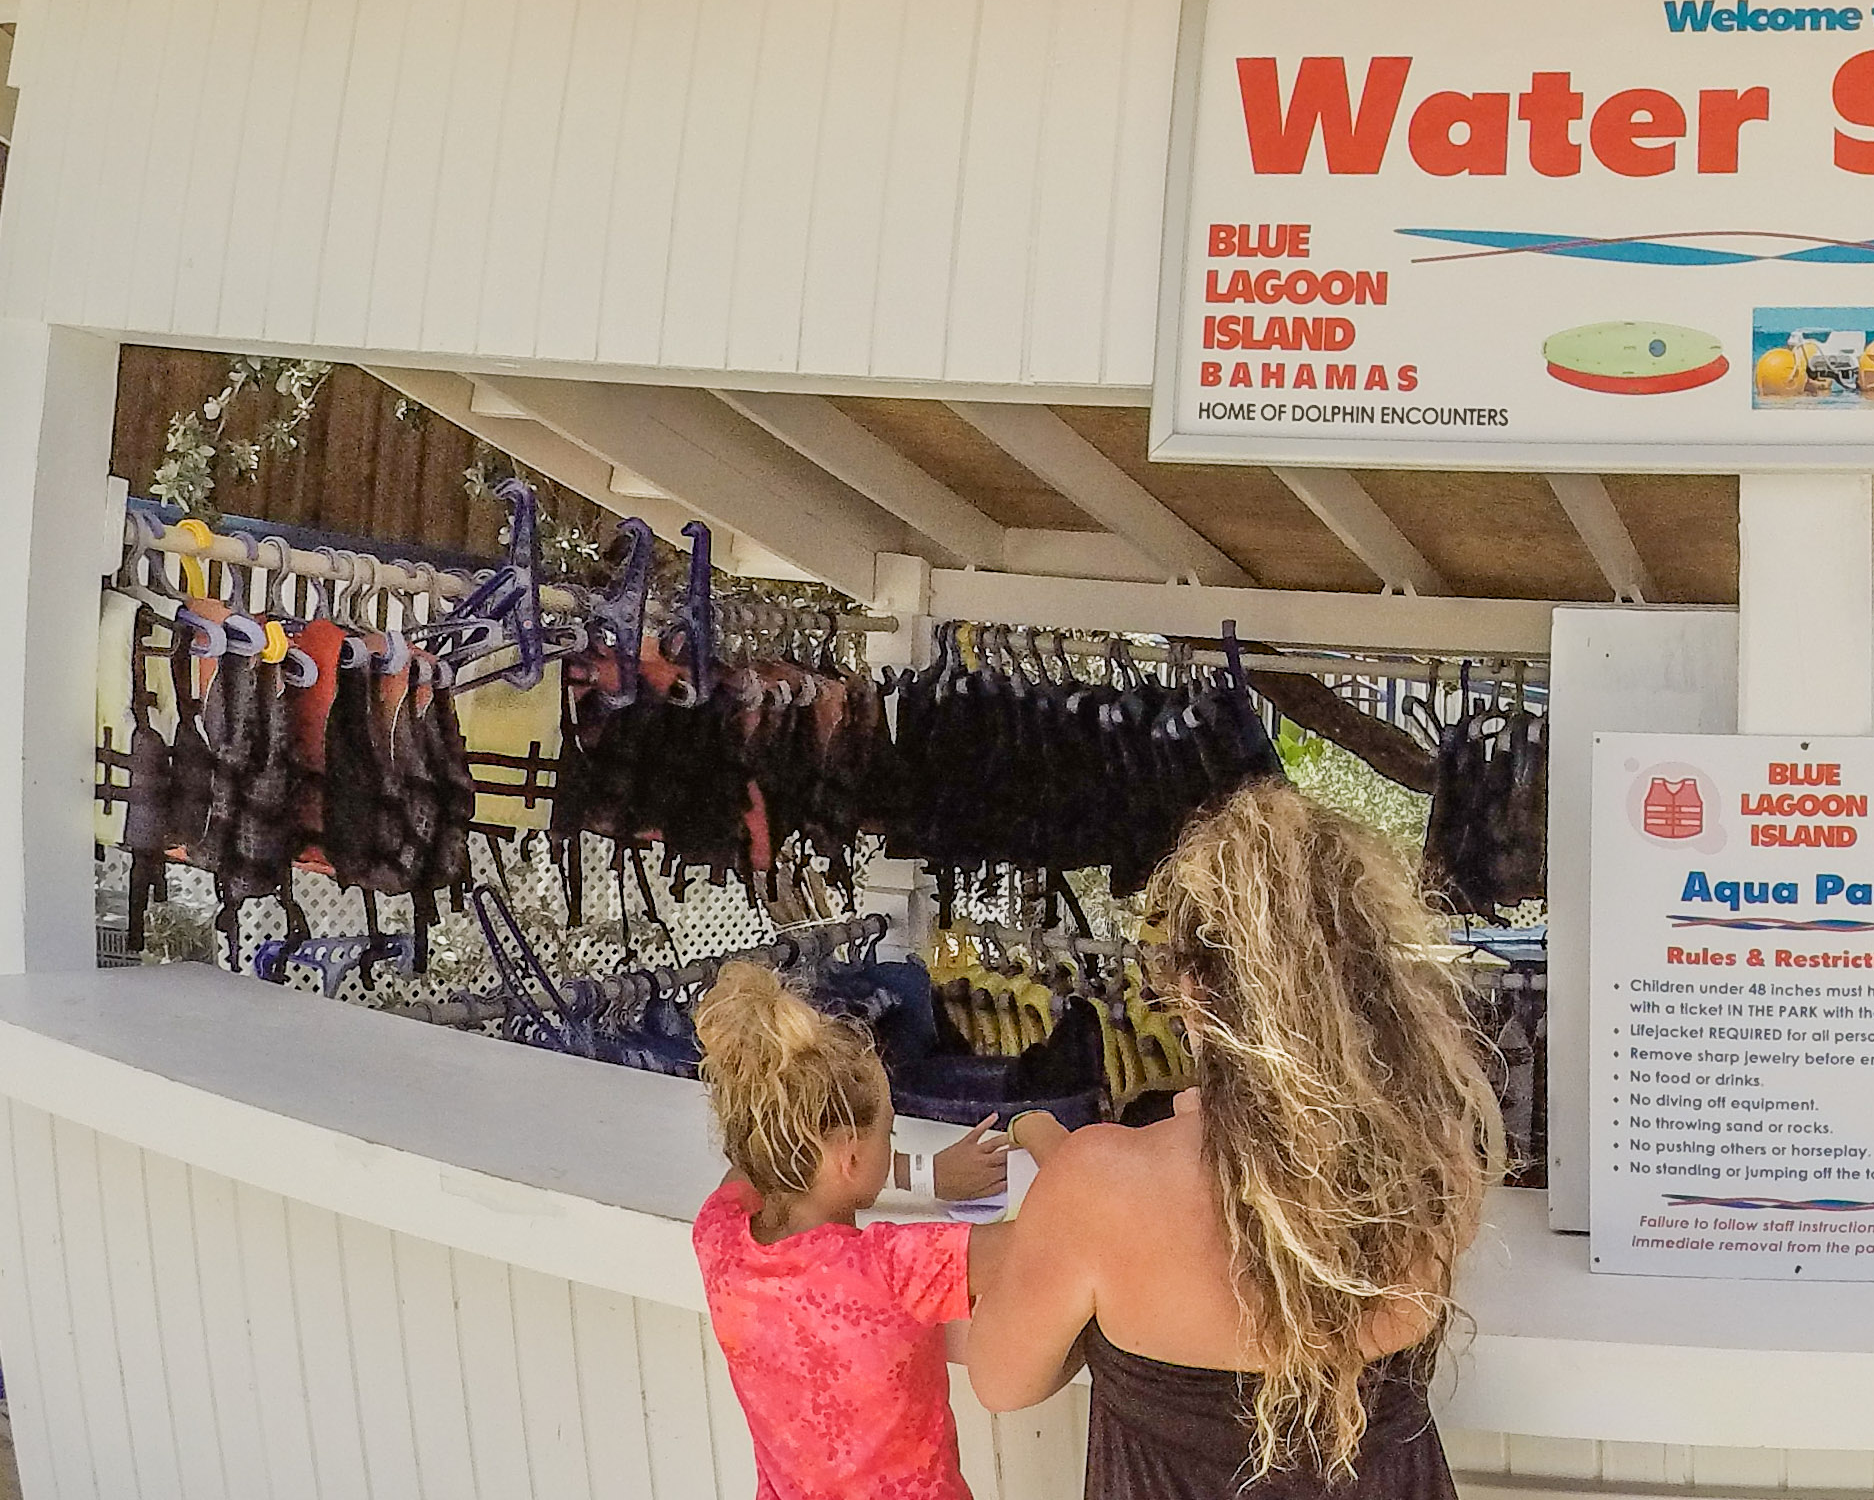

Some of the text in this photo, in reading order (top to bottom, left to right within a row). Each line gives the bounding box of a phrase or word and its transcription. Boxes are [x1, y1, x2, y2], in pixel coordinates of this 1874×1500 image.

[1664, 0, 1863, 32] Welcome
[1236, 57, 1769, 177] Water
[1208, 224, 1311, 258] BLUE
[1206, 269, 1388, 305] LAGOON
[1203, 315, 1355, 351] ISLAND
[1201, 362, 1418, 391] BAHAMAS
[1198, 401, 1509, 427] HOME OF DOLPHIN ENCOUNTERS
[1769, 763, 1841, 786] BLUE
[1741, 793, 1867, 817] LAGOON
[1751, 824, 1857, 847] ISLAND
[1681, 871, 1798, 911] Aqua
[1666, 946, 1737, 967] Rules
[1745, 948, 1766, 967] &
[1630, 979, 1695, 994] Children
[1699, 982, 1745, 995] under
[1748, 982, 1767, 996] 48
[1770, 983, 1821, 997] inches
[1826, 984, 1863, 998] must
[1629, 1000, 1660, 1014] with
[1665, 1004, 1675, 1015] a
[1679, 1002, 1723, 1016] ticket
[1727, 1003, 1743, 1017] IN
[1747, 1004, 1774, 1017] THE
[1778, 1005, 1818, 1019] PARK
[1822, 1005, 1854, 1019] with
[1630, 1023, 1704, 1040] Lifejacket
[1708, 1026, 1783, 1041] REQUIRED
[1786, 1028, 1807, 1042] for
[1811, 1029, 1830, 1042] all
[1630, 1046, 1693, 1062] Remove
[1697, 1049, 1740, 1066] sharp
[1743, 1050, 1800, 1068] jewelry
[1804, 1052, 1855, 1066] before
[1630, 1069, 1764, 1087] No food or drinks.
[1629, 1092, 1819, 1113] No diving off equipment.
[1629, 1115, 1833, 1135] No throwing sand or rocks.
[1630, 1138, 1871, 1160] No pushing others or horseplay.
[1629, 1161, 1651, 1174] No
[1655, 1162, 1721, 1180] standing
[1725, 1167, 1741, 1178] or
[1744, 1165, 1808, 1182] jumping
[1813, 1166, 1833, 1180] off
[1836, 1167, 1861, 1180] the
[1639, 1215, 1690, 1230] Failure
[1693, 1217, 1709, 1230] to
[1713, 1217, 1759, 1231] follow
[1762, 1219, 1795, 1233] staff
[1631, 1234, 1715, 1251] immediate
[1718, 1240, 1783, 1253] removal
[1786, 1240, 1822, 1253] from
[1826, 1241, 1851, 1254] the
